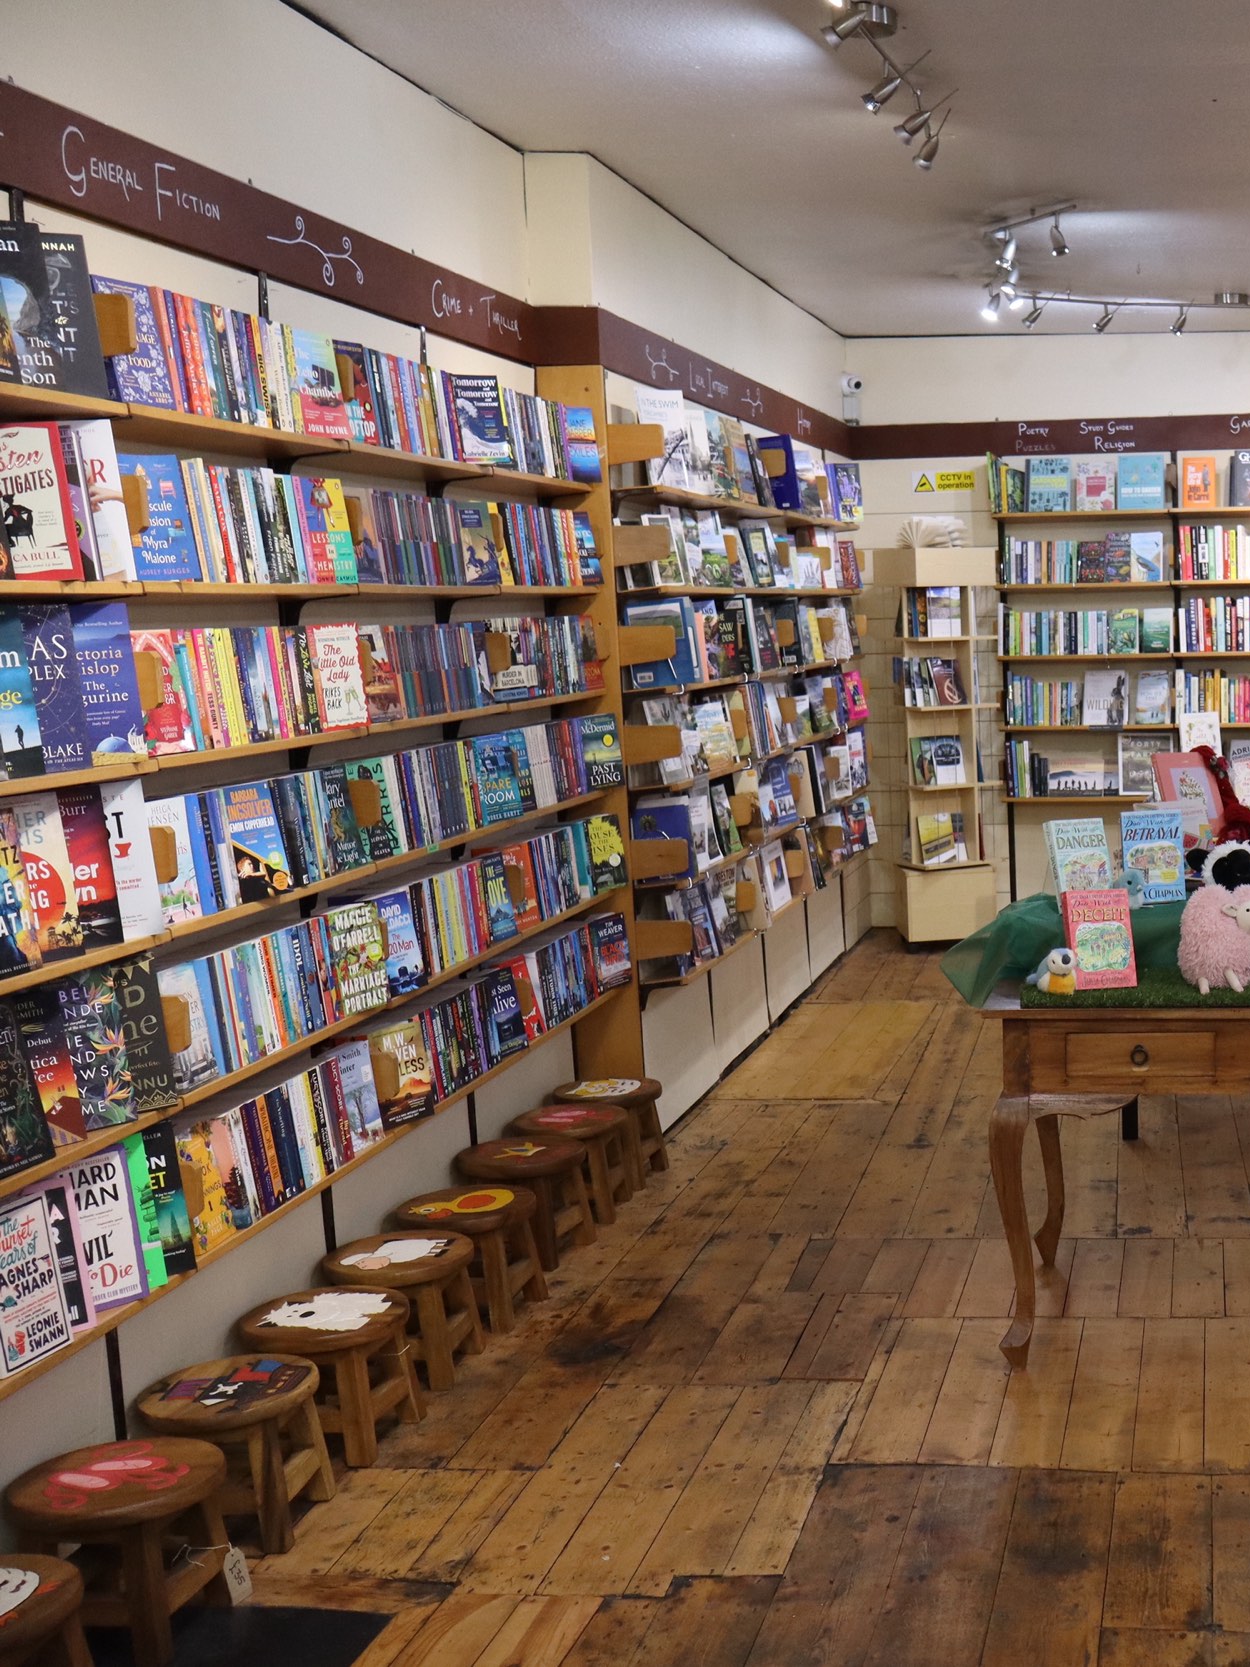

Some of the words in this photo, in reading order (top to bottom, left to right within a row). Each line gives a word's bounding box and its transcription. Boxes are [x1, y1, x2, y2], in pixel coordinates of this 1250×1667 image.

[155, 162, 221, 221] FICTION
[28, 336, 51, 349] The
[21, 370, 56, 386] Son
[452, 376, 496, 388] Tomorrow
[261, 376, 271, 418] SWISS
[456, 389, 498, 398] Tomorrow
[308, 423, 325, 434] JOHN
[325, 424, 348, 435] BOYNE
[938, 481, 974, 490] operation
[142, 535, 168, 551] Myra
[311, 532, 346, 544] LESSONS
[31, 552, 60, 562] BULL
[142, 551, 177, 564] Malone
[323, 644, 342, 656] The
[339, 656, 356, 668] Old
[327, 670, 350, 682] Lady
[83, 681, 106, 691] The
[327, 698, 342, 710] BACK
[581, 722, 615, 734] McDermid
[592, 762, 616, 775] PAST
[590, 772, 621, 786] LYING
[230, 788, 259, 803] BARBARA
[244, 817, 275, 831] COPPERHEAD
[1124, 827, 1180, 842] BETRAYAL
[1056, 835, 1106, 850] DANGER
[486, 867, 495, 878] THE
[1148, 888, 1183, 900] CHAPMAN
[334, 907, 373, 929] MAGGIE
[381, 905, 401, 918] DAVID
[1071, 909, 1126, 922] DECEIT
[332, 926, 381, 950] O'FARRELL
[598, 925, 623, 938] WEAVER
[392, 934, 400, 944] The
[399, 940, 414, 951] Man
[292, 939, 302, 970] IDOL
[340, 969, 388, 996] MARRIAGE
[344, 987, 389, 1014] PORTRAIT
[26, 1037, 53, 1048] Debut
[0, 1256, 39, 1287] AGNES
[101, 1262, 134, 1288] Die
[13, 1268, 54, 1300] SHARP
[26, 1311, 60, 1339] LEONIE
[29, 1323, 65, 1353] SWANN
